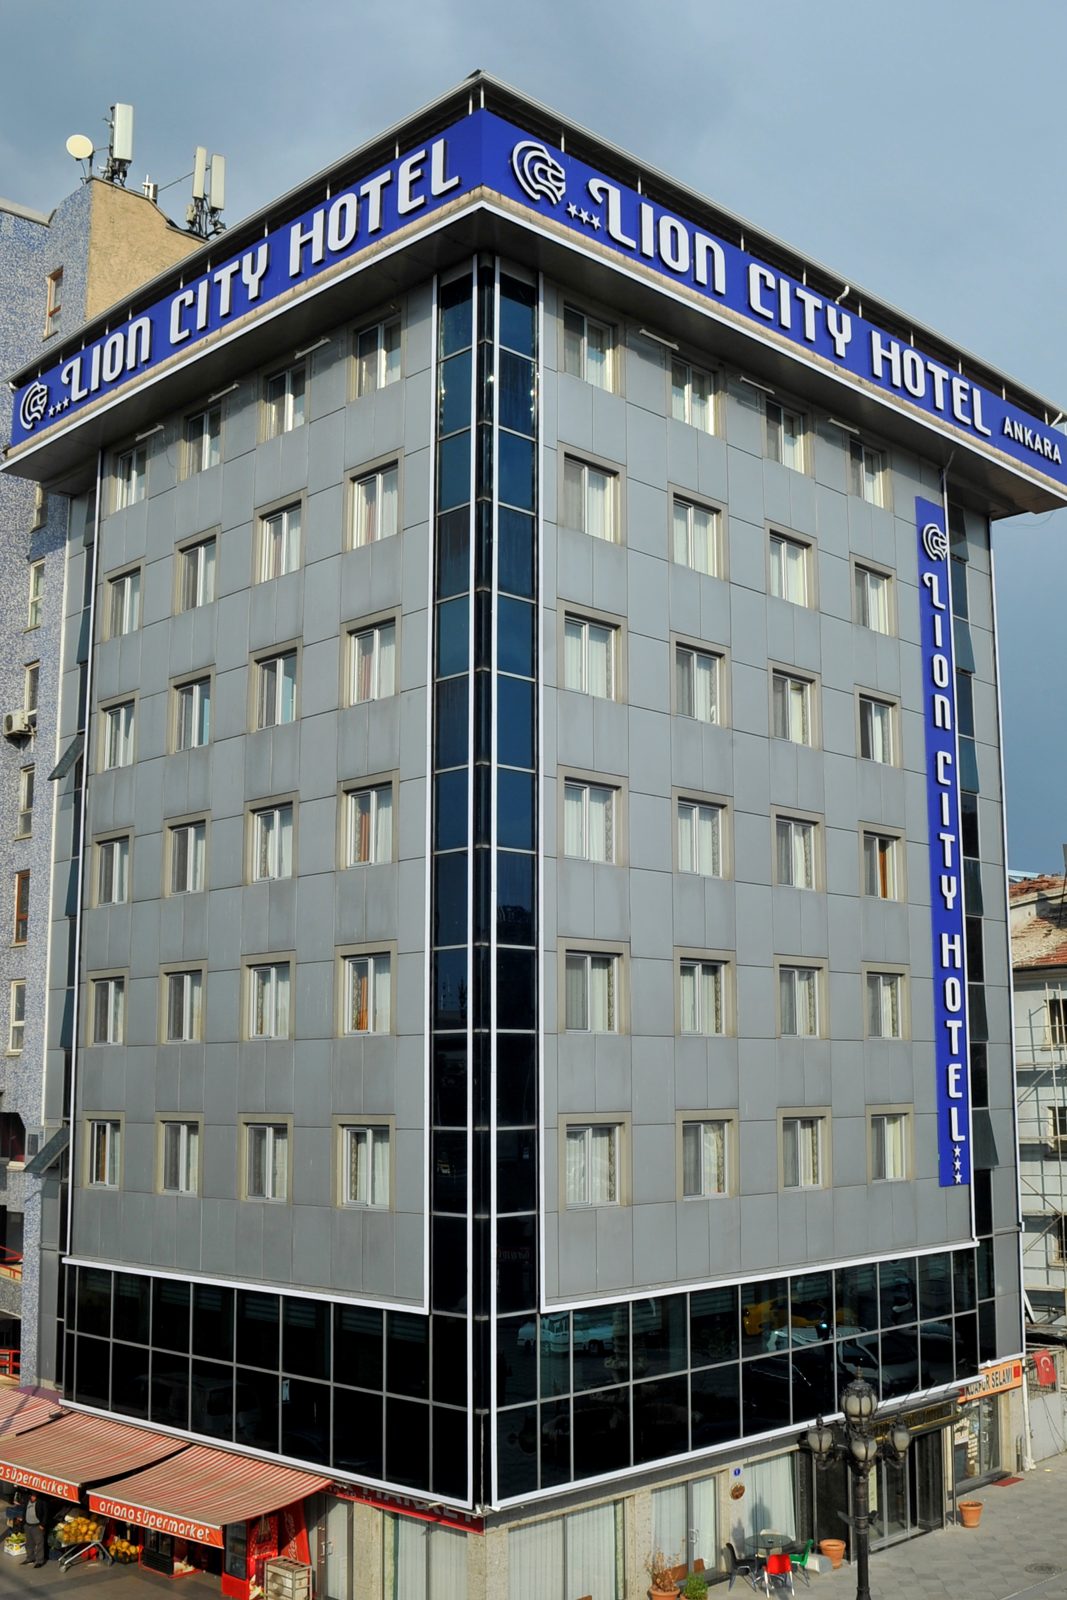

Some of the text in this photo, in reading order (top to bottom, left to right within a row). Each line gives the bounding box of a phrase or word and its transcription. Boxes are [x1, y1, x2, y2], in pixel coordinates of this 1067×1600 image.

[169, 243, 268, 345] CITY
[289, 138, 460, 277] HOTEL
[749, 263, 852, 358] CITY
[872, 330, 992, 437] HOTEL
[1003, 416, 1062, 465] ANKARA
[936, 751, 957, 910] CITY
[941, 933, 966, 1142] HOTEL
[99, 1501, 210, 1542] ariana süpermarket
